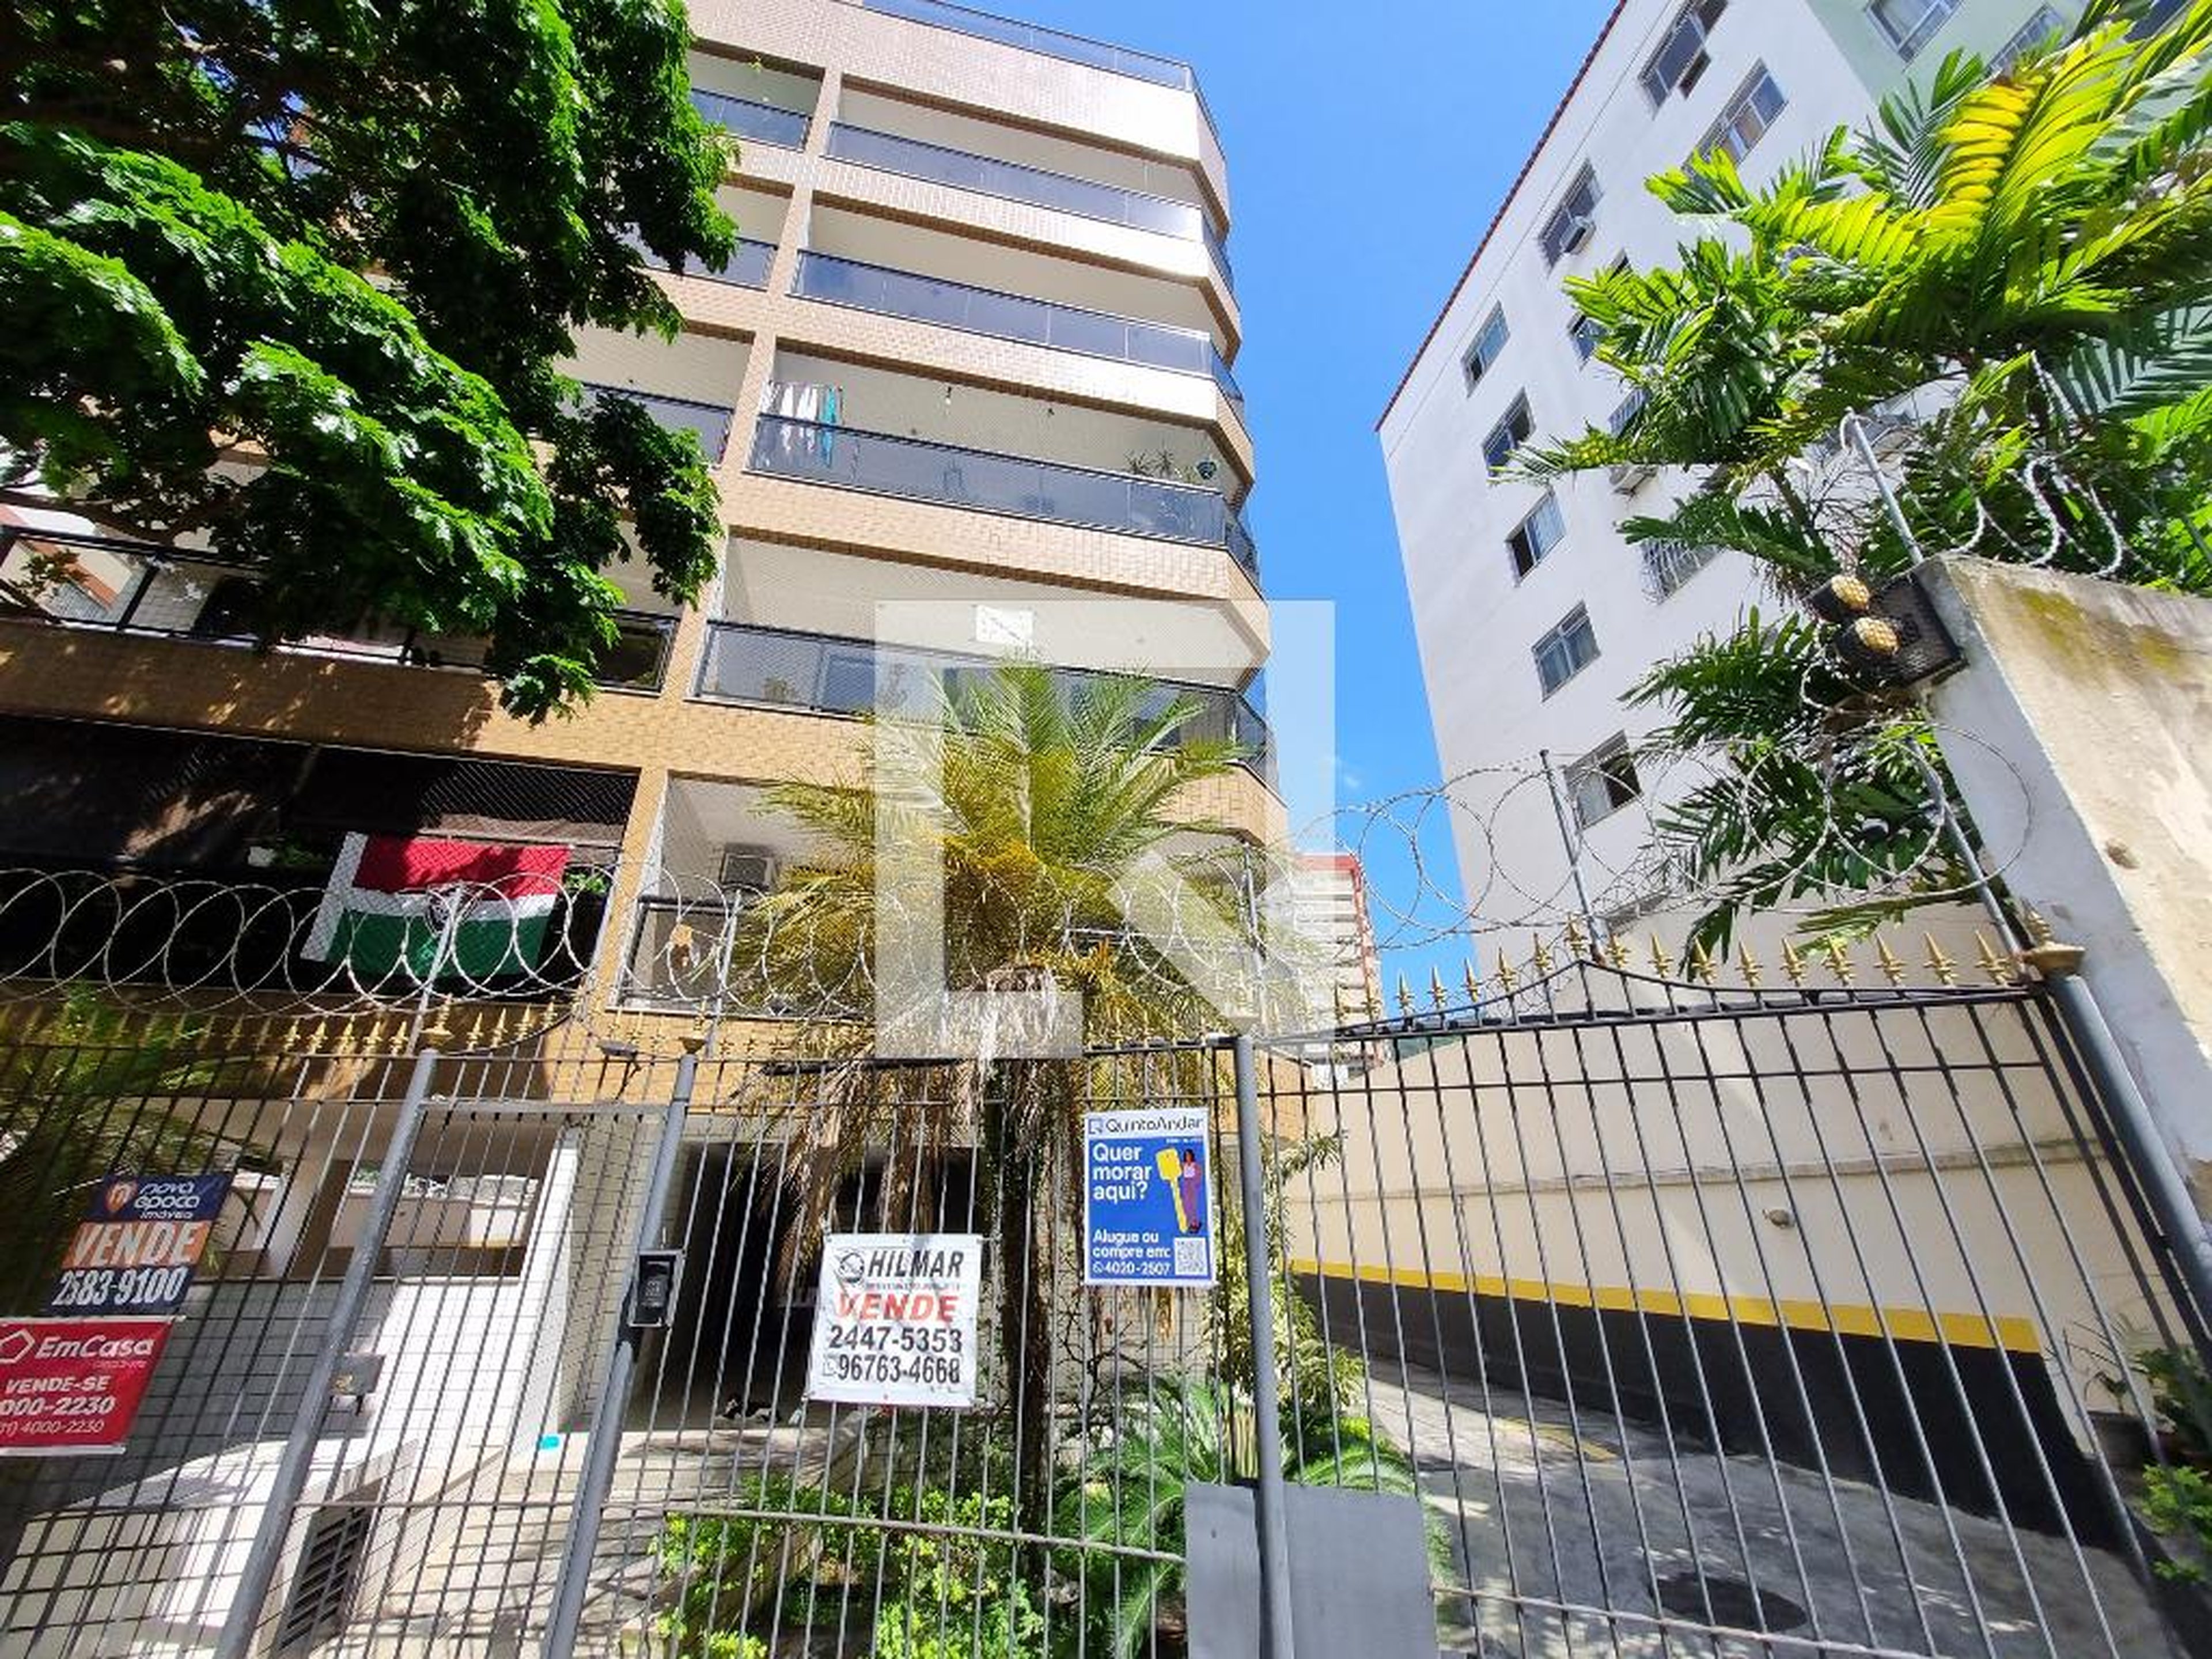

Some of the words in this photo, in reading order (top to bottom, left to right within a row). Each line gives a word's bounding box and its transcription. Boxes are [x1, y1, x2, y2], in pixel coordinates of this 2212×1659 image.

[1105, 1116, 1203, 1132] QuintoAndar
[1092, 1142, 1142, 1162] Quer
[1093, 1166, 1152, 1180] morar
[139, 1183, 195, 1194] nova
[1094, 1181, 1148, 1204] aqui?
[73, 1222, 204, 1267] VENDE
[1093, 1229, 1139, 1247] Alugue
[1142, 1232, 1158, 1243] ou
[868, 1251, 964, 1278] HILMAR
[51, 1267, 189, 1306] 2583-9100
[835, 1293, 958, 1322] VENDE
[35, 1334, 154, 1359] EmCasa
[829, 1325, 962, 1353] 2447-5353
[5, 1376, 111, 1394] VENDE-SE
